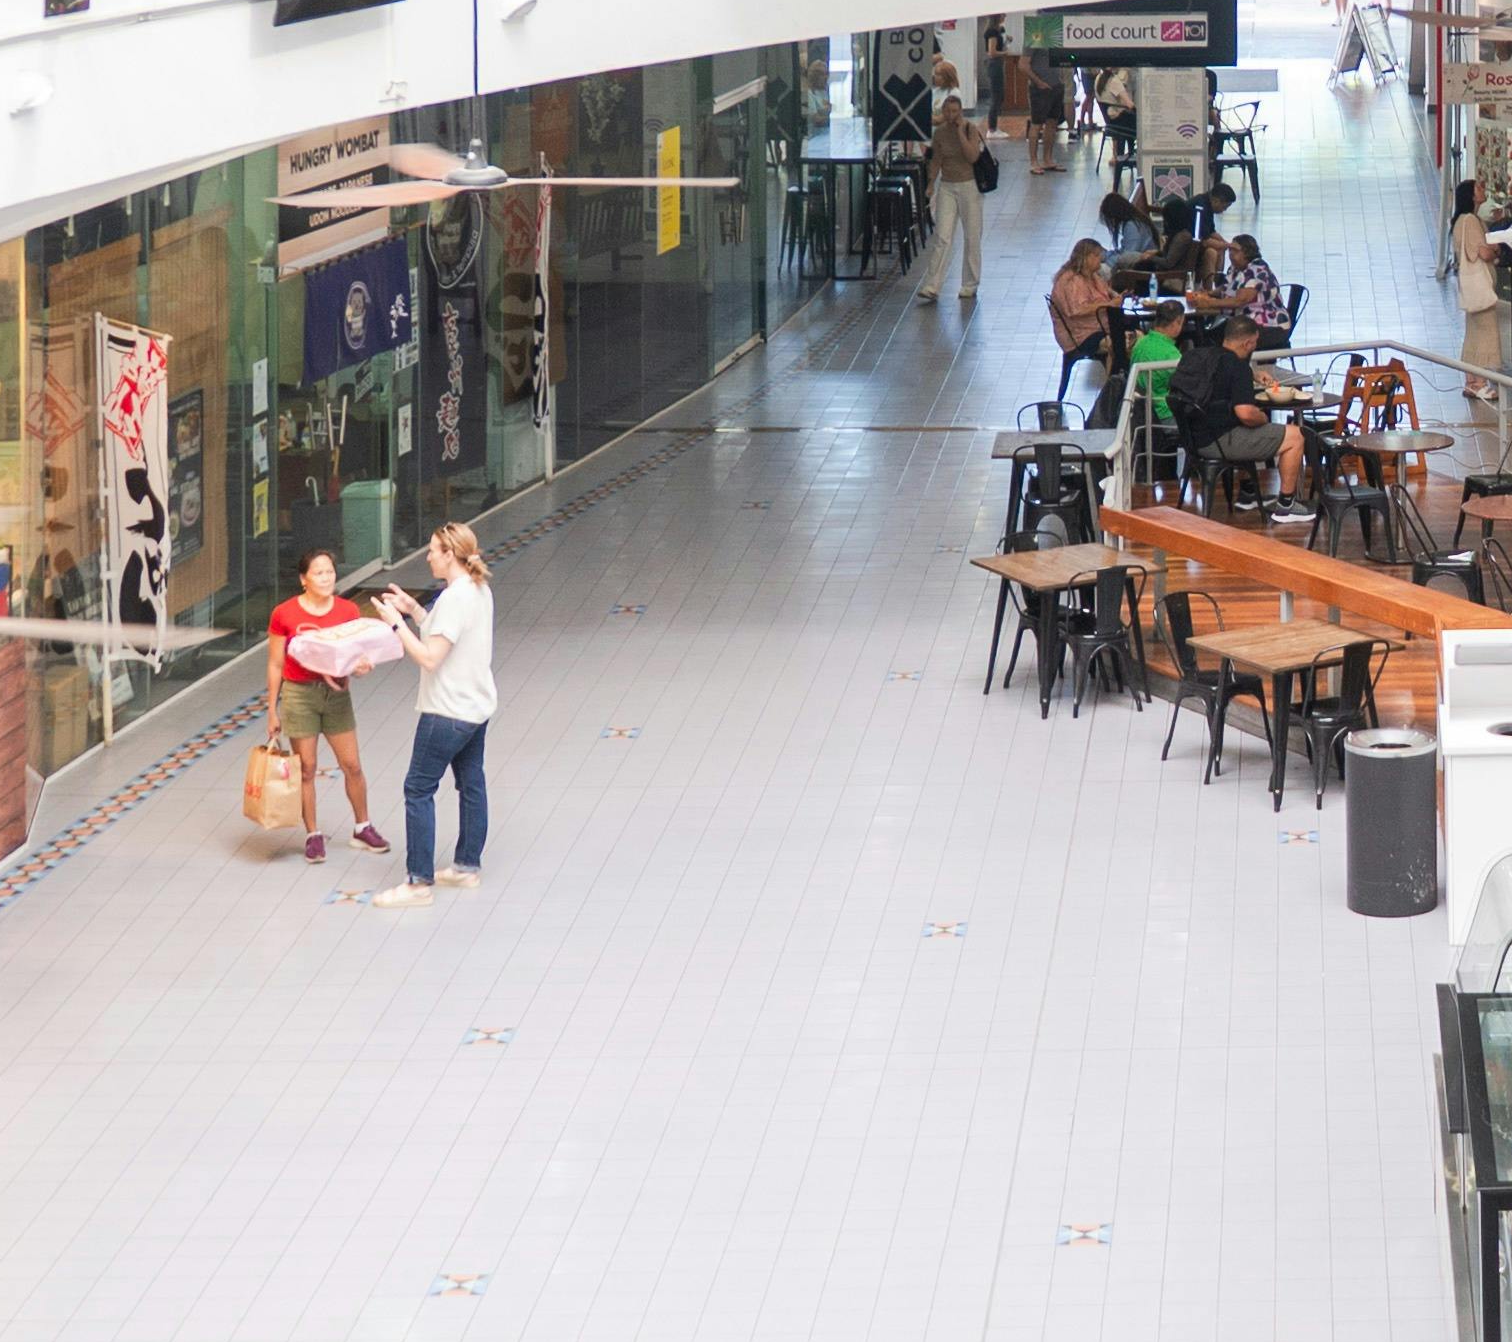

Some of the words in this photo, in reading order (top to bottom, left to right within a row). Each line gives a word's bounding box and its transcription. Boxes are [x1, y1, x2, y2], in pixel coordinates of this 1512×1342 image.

[1065, 22, 1105, 41] food
[1111, 24, 1157, 41] court
[289, 143, 334, 175] HUNGRY
[335, 129, 380, 159] WOMBAT
[308, 210, 330, 228] UDON
